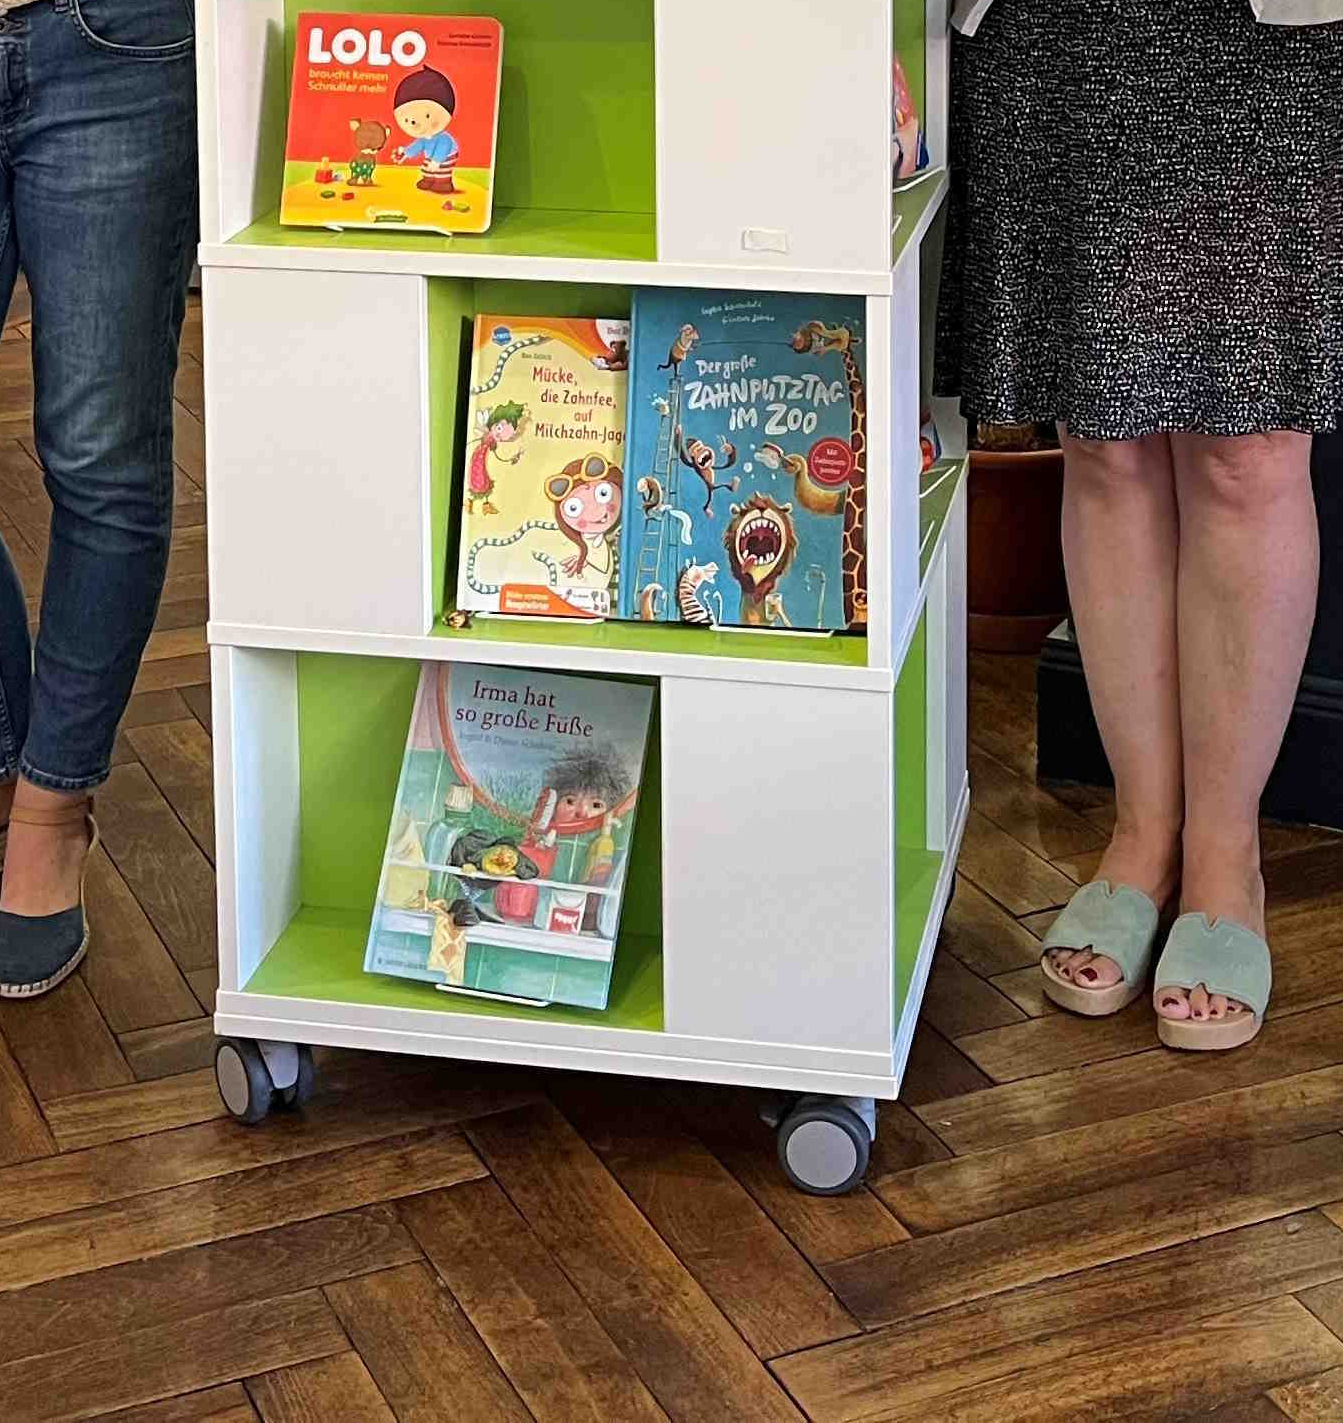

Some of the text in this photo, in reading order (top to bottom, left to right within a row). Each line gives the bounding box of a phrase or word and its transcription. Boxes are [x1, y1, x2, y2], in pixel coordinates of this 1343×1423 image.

[308, 27, 427, 67] LOLO
[309, 68, 389, 82] braucht keinen
[308, 81, 388, 93] Schnuller mehr
[532, 365, 578, 386] Mücke,
[695, 355, 757, 378] Der große
[540, 388, 617, 410] die Zahnfee,
[684, 374, 845, 411] ZAHNPUTZTAG
[574, 409, 593, 423] auf
[764, 403, 818, 435] ZOO
[472, 680, 556, 709] Irma hat
[455, 707, 595, 737] so große Füße
